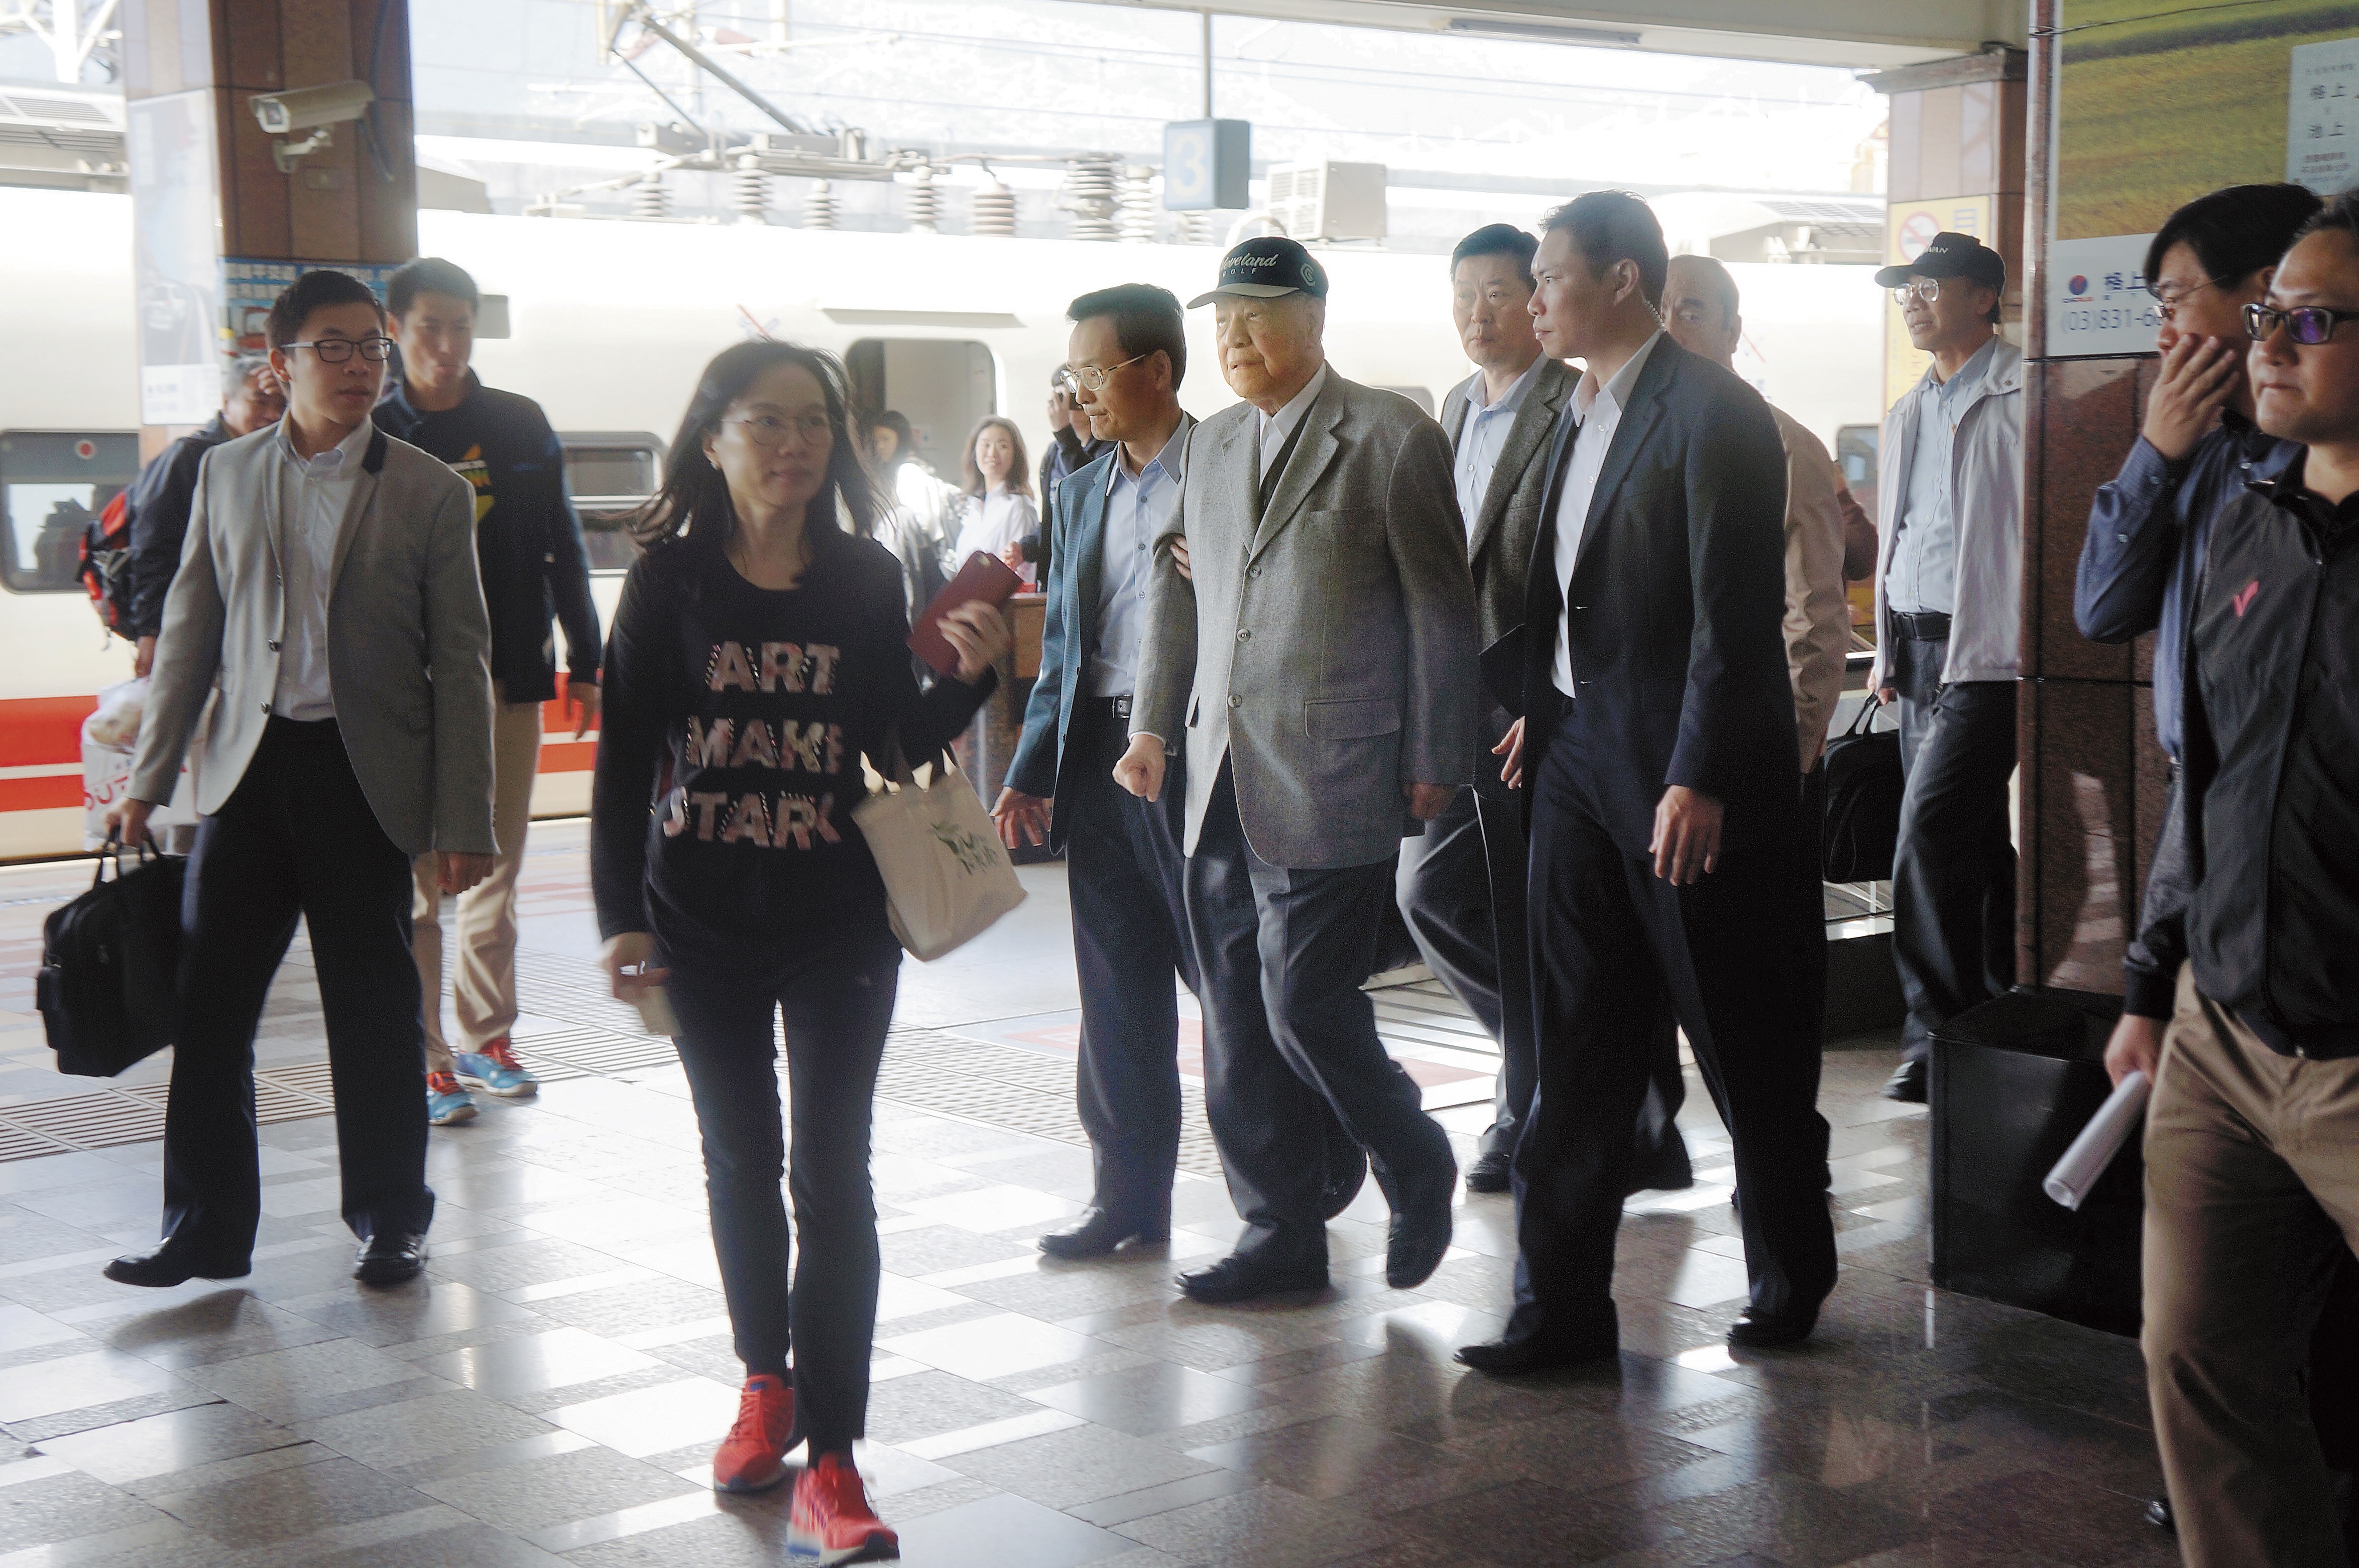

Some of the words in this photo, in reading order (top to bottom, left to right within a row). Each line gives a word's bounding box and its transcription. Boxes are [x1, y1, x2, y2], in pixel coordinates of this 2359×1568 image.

[1171, 133, 1204, 197] 3
[1222, 268, 1257, 278] GOLF
[705, 640, 841, 695] ART
